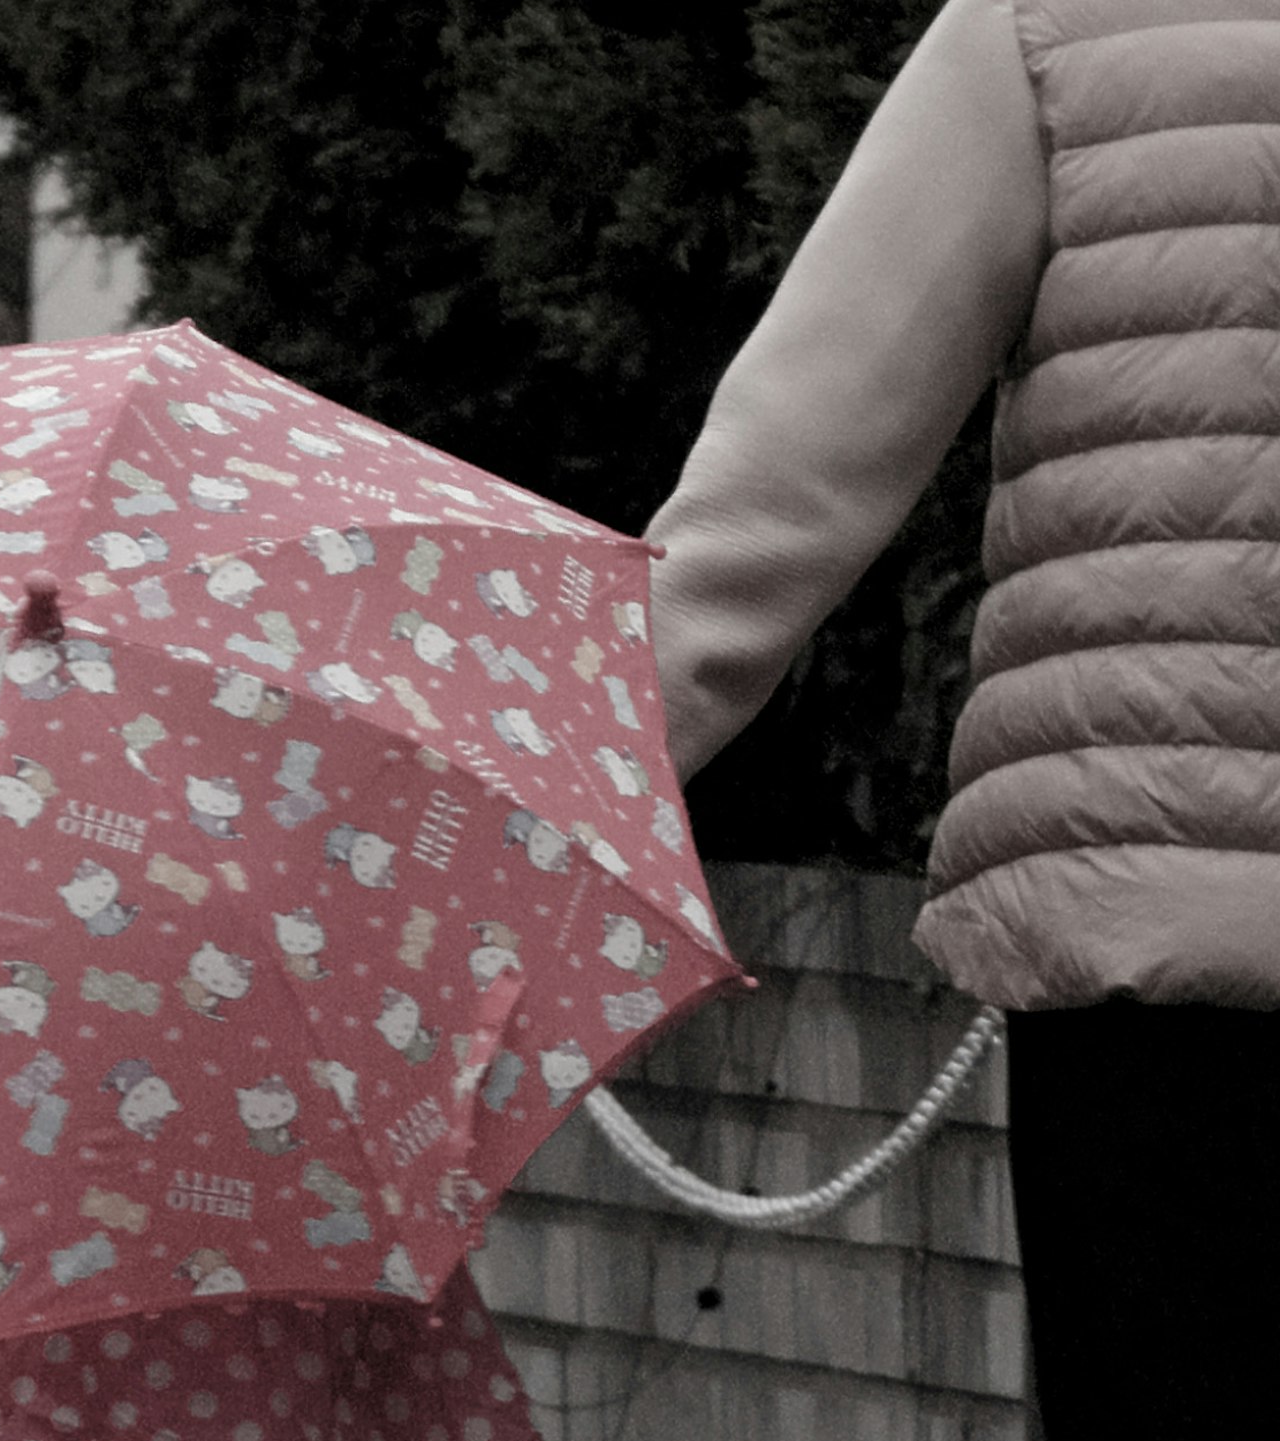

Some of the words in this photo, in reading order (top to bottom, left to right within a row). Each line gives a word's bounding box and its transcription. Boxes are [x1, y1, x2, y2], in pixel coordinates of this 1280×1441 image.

[56, 816, 143, 854] HELLO
[66, 799, 148, 836] KITTY
[410, 788, 451, 863] HELLO
[429, 803, 468, 872] KITTY
[164, 1187, 253, 1221] HELLO
[174, 1170, 255, 1201] KITTY
